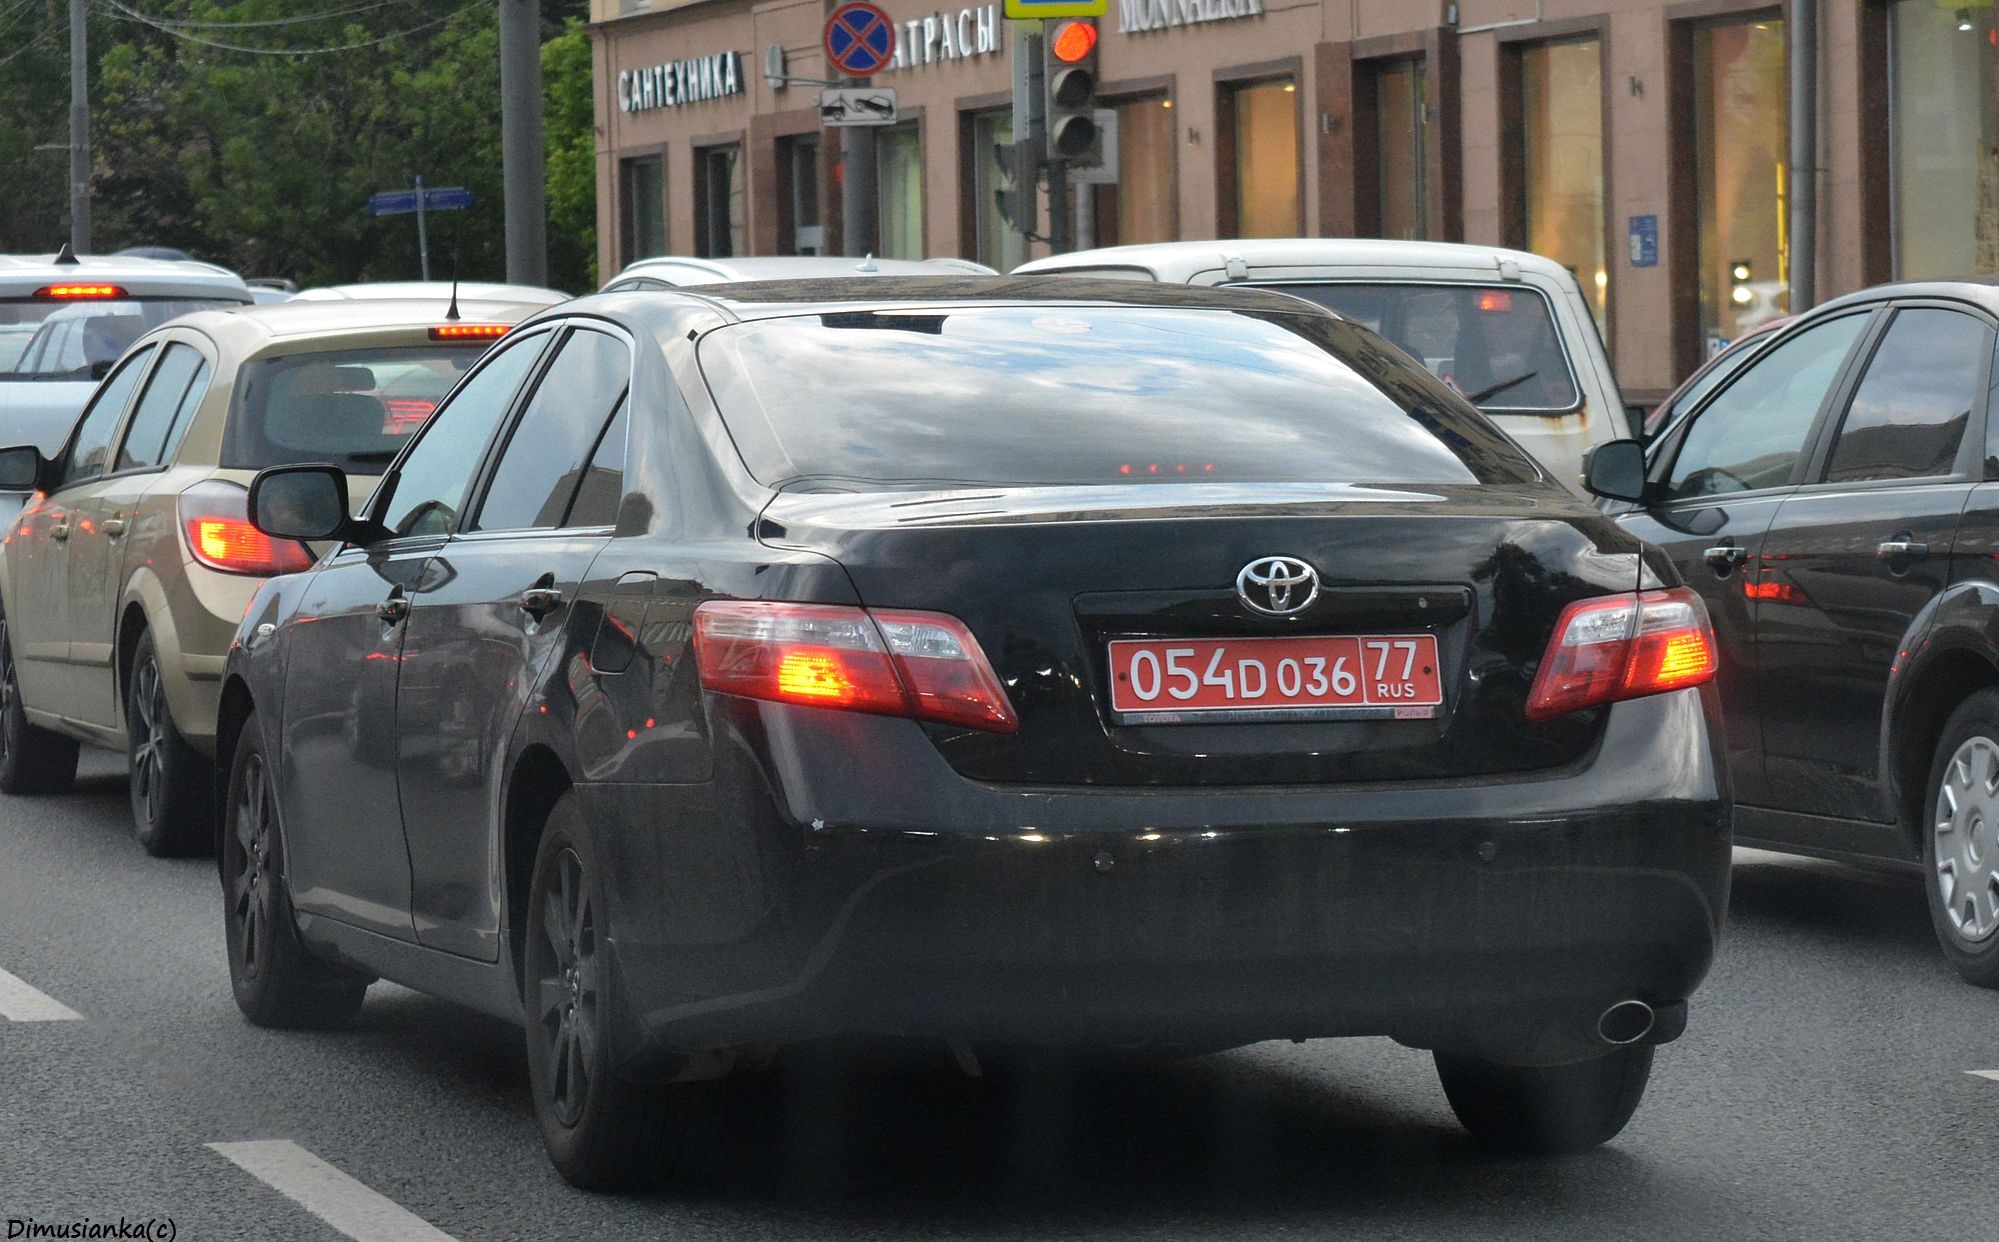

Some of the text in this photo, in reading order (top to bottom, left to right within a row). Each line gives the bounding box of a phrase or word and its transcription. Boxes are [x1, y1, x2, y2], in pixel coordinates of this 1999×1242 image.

[885, 4, 1000, 70] АТРАСЫ
[618, 51, 740, 112] САНТЕХНИКА
[1366, 641, 1417, 681] 77
[1377, 683, 1416, 698] RUS
[1142, 714, 1182, 724] TOYOTA
